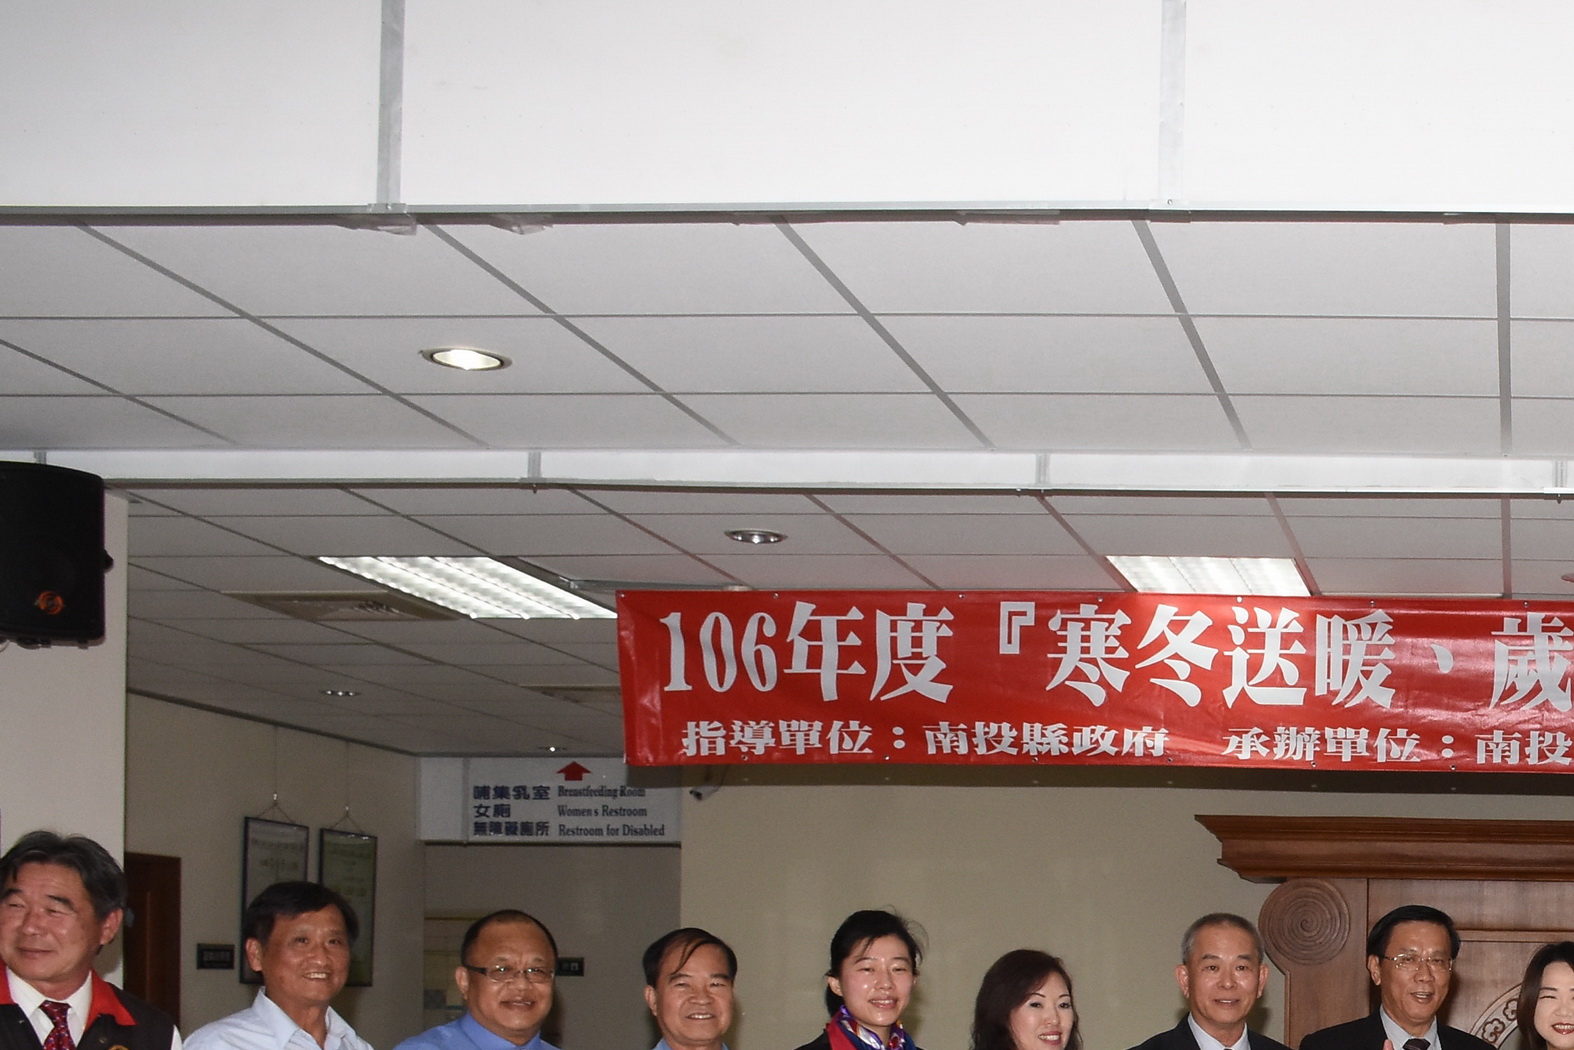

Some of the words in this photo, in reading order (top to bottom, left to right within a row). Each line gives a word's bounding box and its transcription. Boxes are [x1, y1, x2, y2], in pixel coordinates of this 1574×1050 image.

[681, 720, 1170, 758] 指導單位：南投縣政府
[619, 785, 646, 798] Room
[473, 803, 511, 818] 女廁
[602, 804, 648, 817] Restroom
[559, 824, 603, 837] Restroom
[606, 824, 620, 837] for
[622, 824, 666, 837] Disabled
